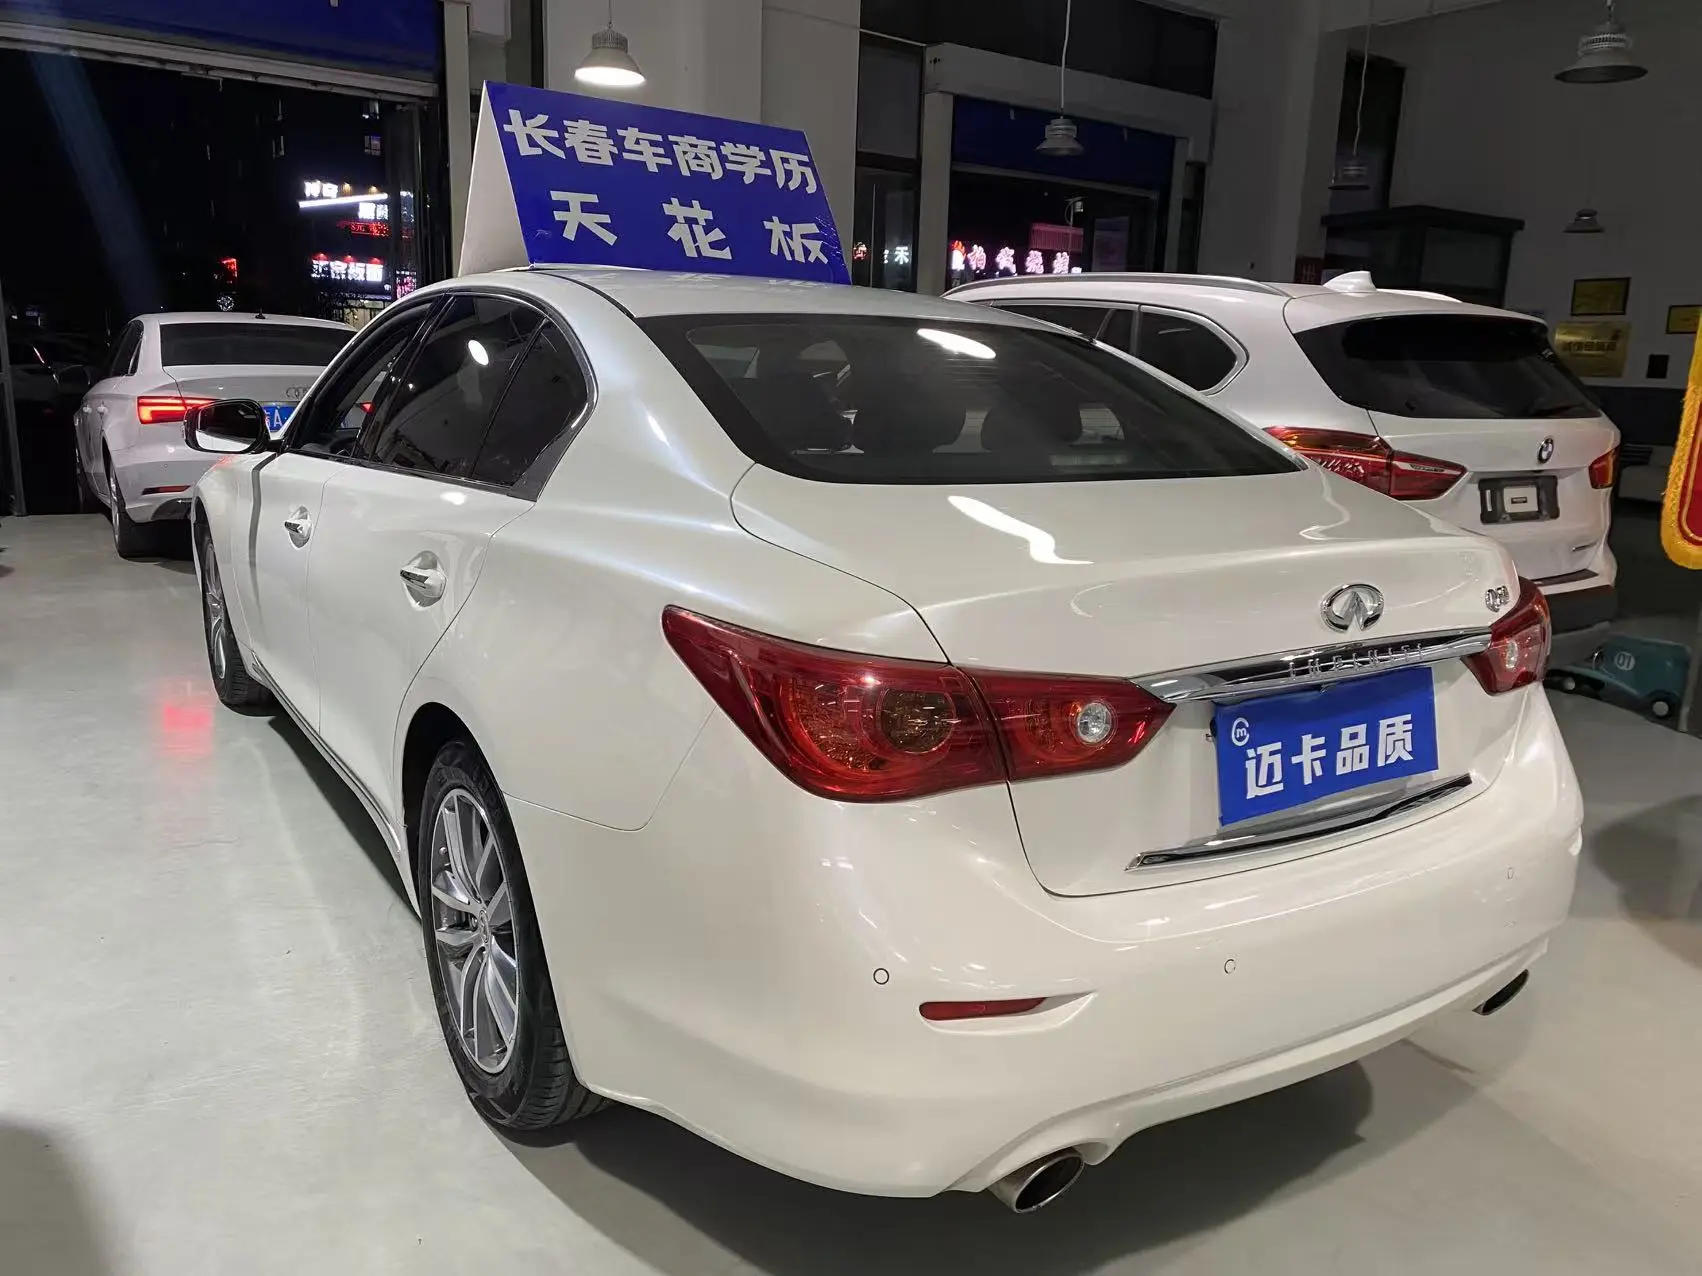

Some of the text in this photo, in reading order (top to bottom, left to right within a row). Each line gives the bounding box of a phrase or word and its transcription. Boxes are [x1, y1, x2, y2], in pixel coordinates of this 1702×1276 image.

[503, 108, 818, 195] 长春车商学历
[550, 190, 829, 265] 天花板
[1245, 713, 1414, 800] 迈卡品质
